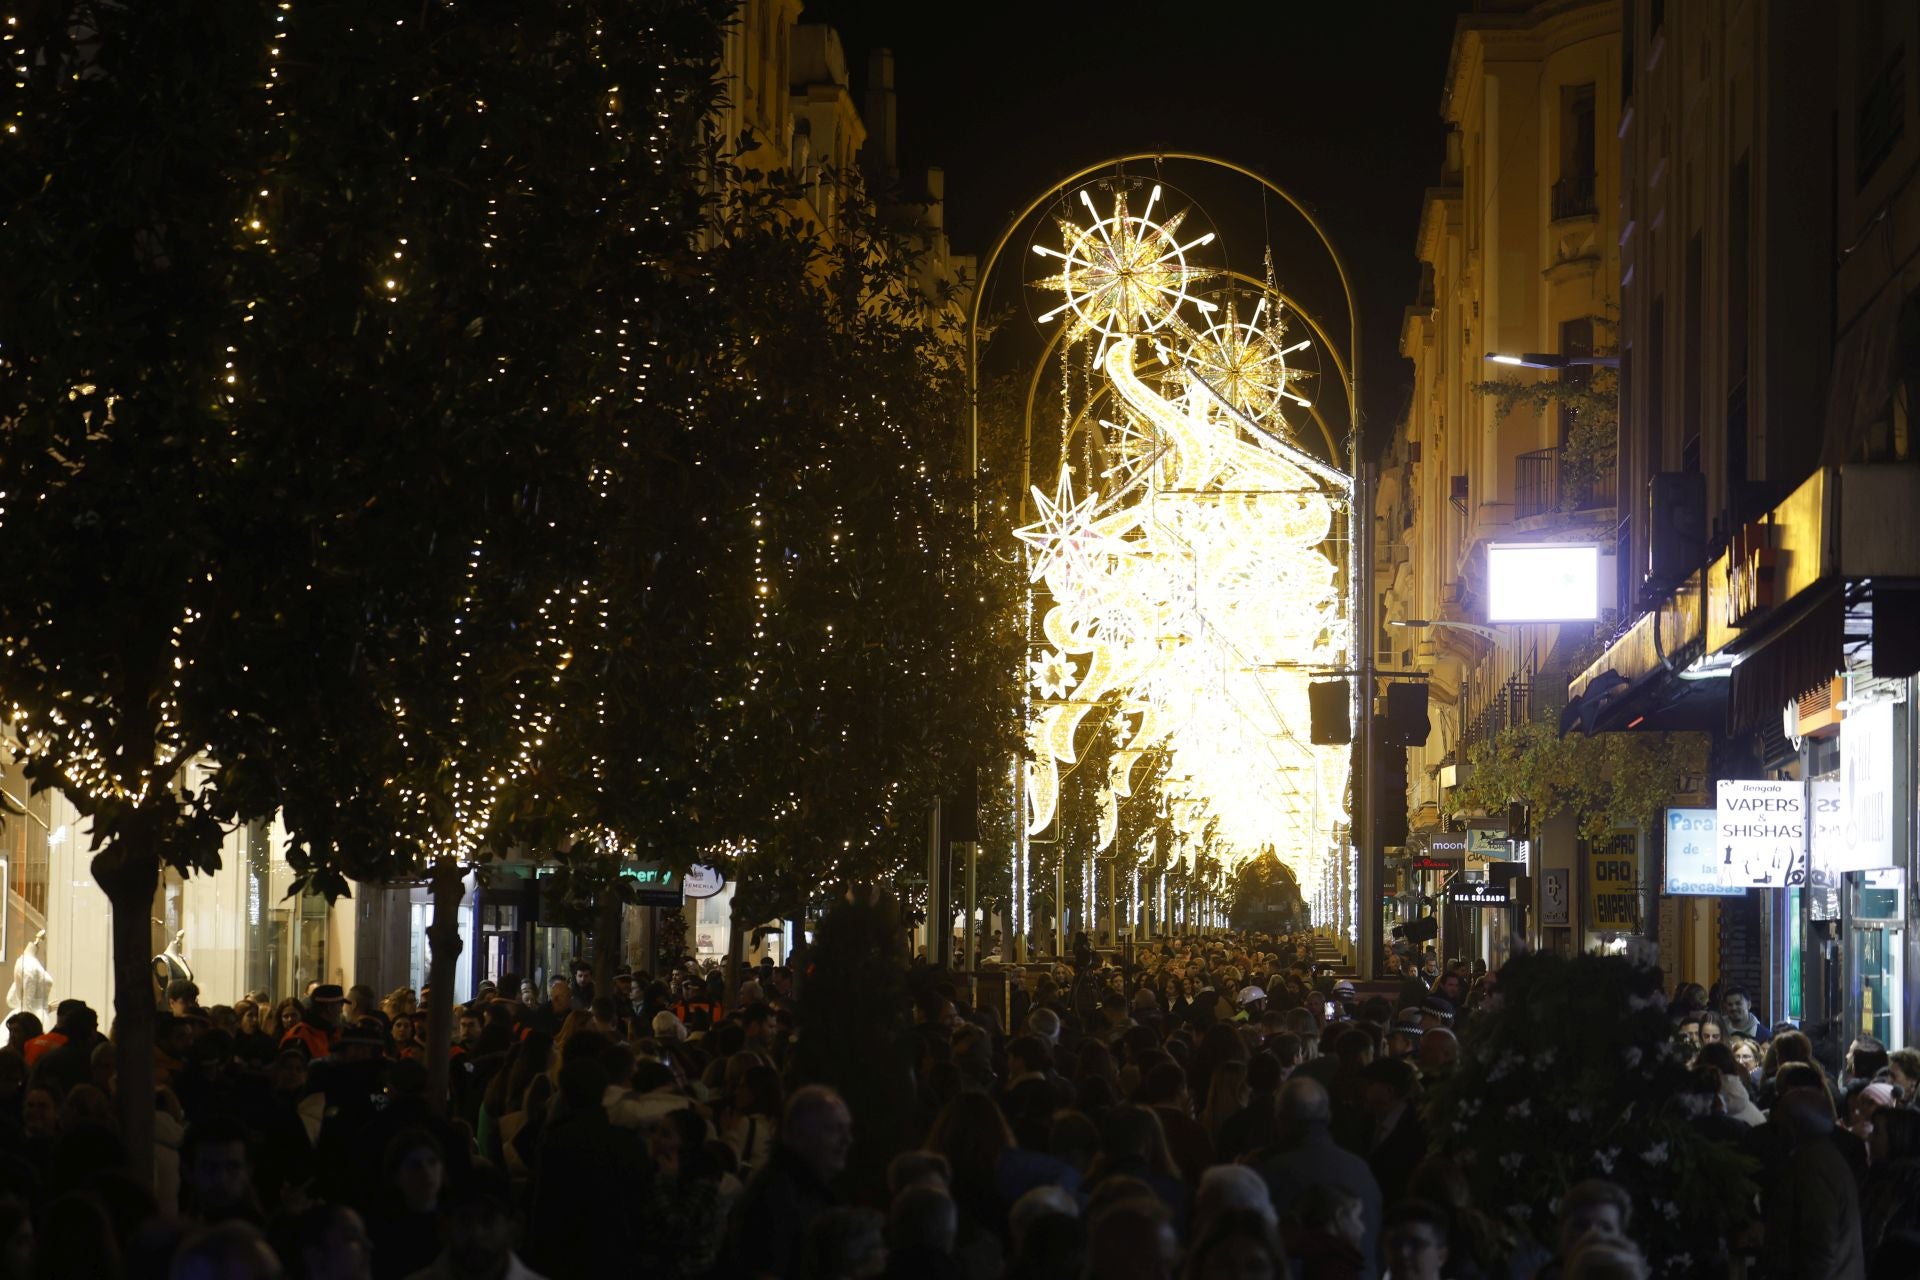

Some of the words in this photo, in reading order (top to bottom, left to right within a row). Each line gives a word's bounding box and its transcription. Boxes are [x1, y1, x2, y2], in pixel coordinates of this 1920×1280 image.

[1743, 784, 1782, 793] Bengala
[1726, 798, 1799, 812] VAPERS
[1758, 814, 1767, 822] &
[1723, 824, 1803, 838] SHISHAS
[1682, 843, 1700, 855] de
[1596, 861, 1631, 880] ORO
